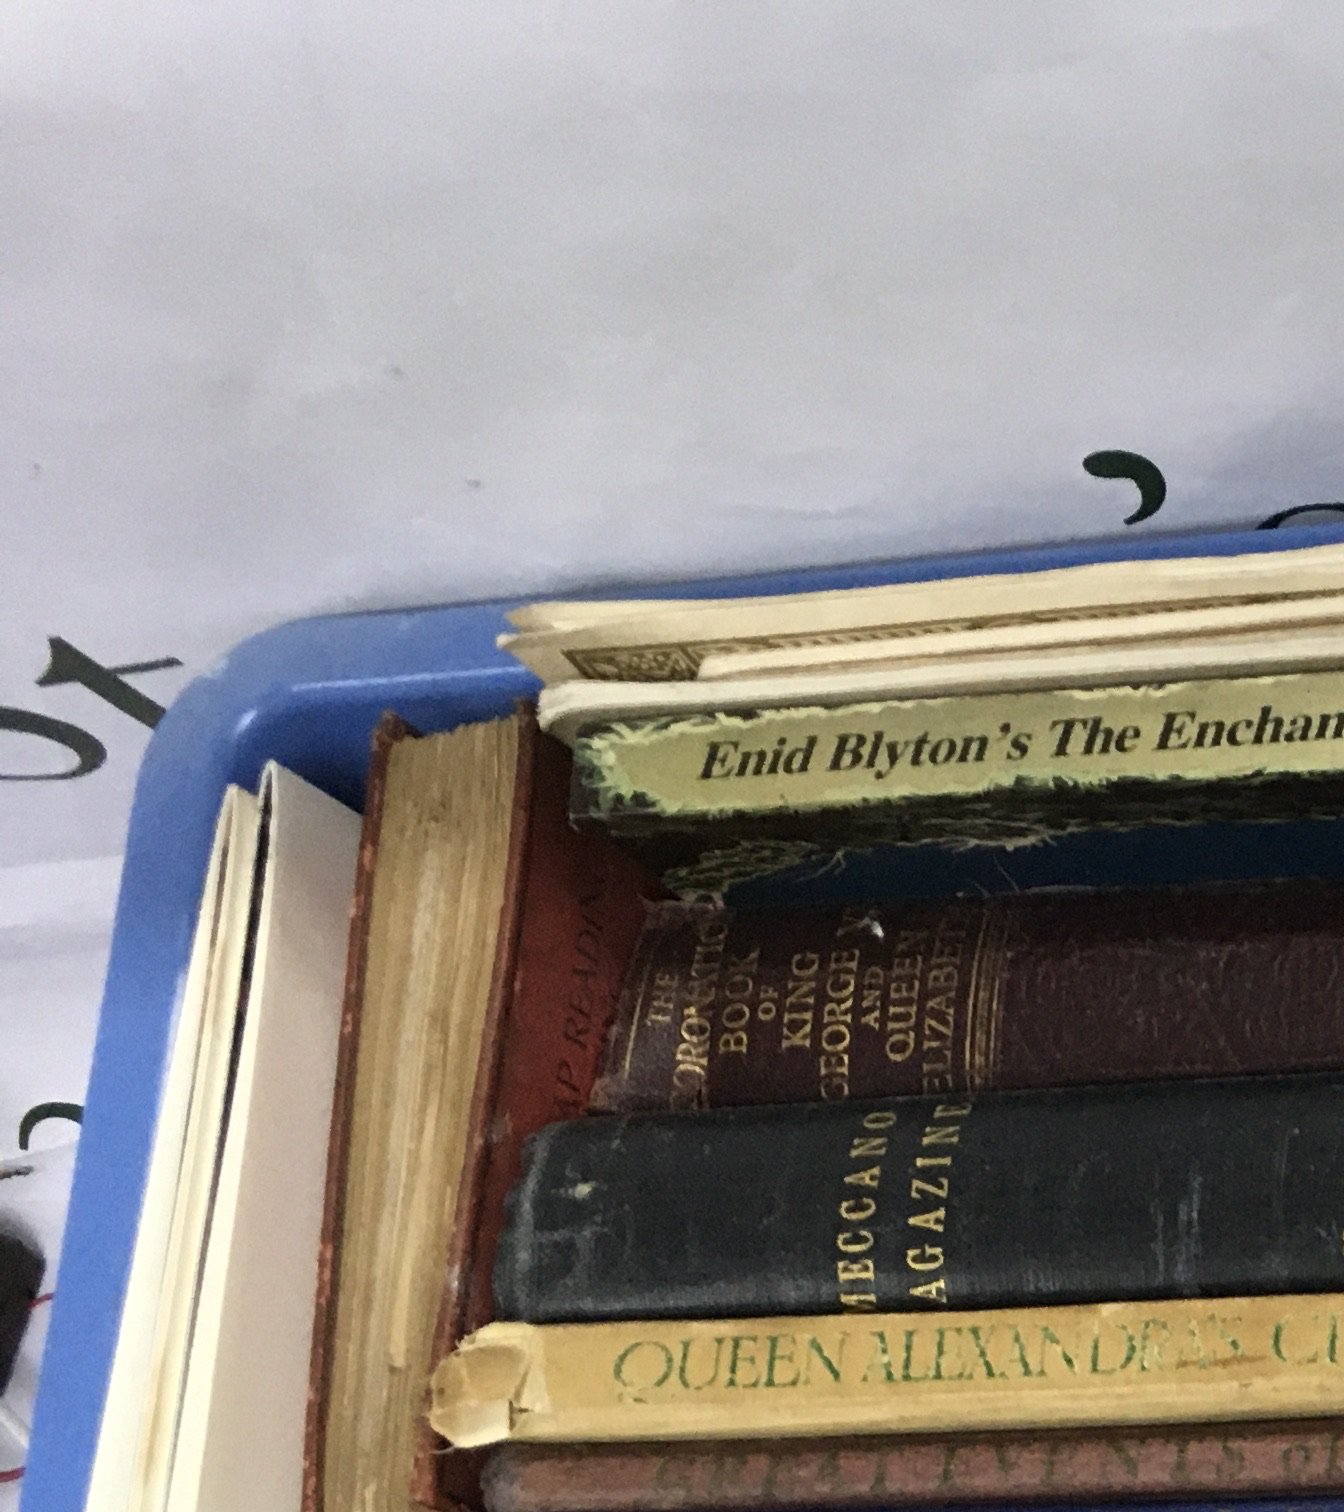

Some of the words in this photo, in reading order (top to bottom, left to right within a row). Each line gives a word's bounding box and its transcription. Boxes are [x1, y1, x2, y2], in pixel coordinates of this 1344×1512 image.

[697, 734, 817, 780] Enid
[827, 721, 1033, 780] Blyton's
[1048, 715, 1142, 759] The
[644, 970, 681, 1027] THE
[718, 946, 761, 1055] BOOK
[756, 984, 779, 1022] OF
[779, 951, 821, 1050] KING
[818, 949, 861, 1101] GEORGE
[859, 965, 886, 1032] AND
[884, 928, 931, 1063] QUEEN
[904, 1100, 974, 1304] AGAZINE
[612, 1330, 850, 1403] QUEEN
